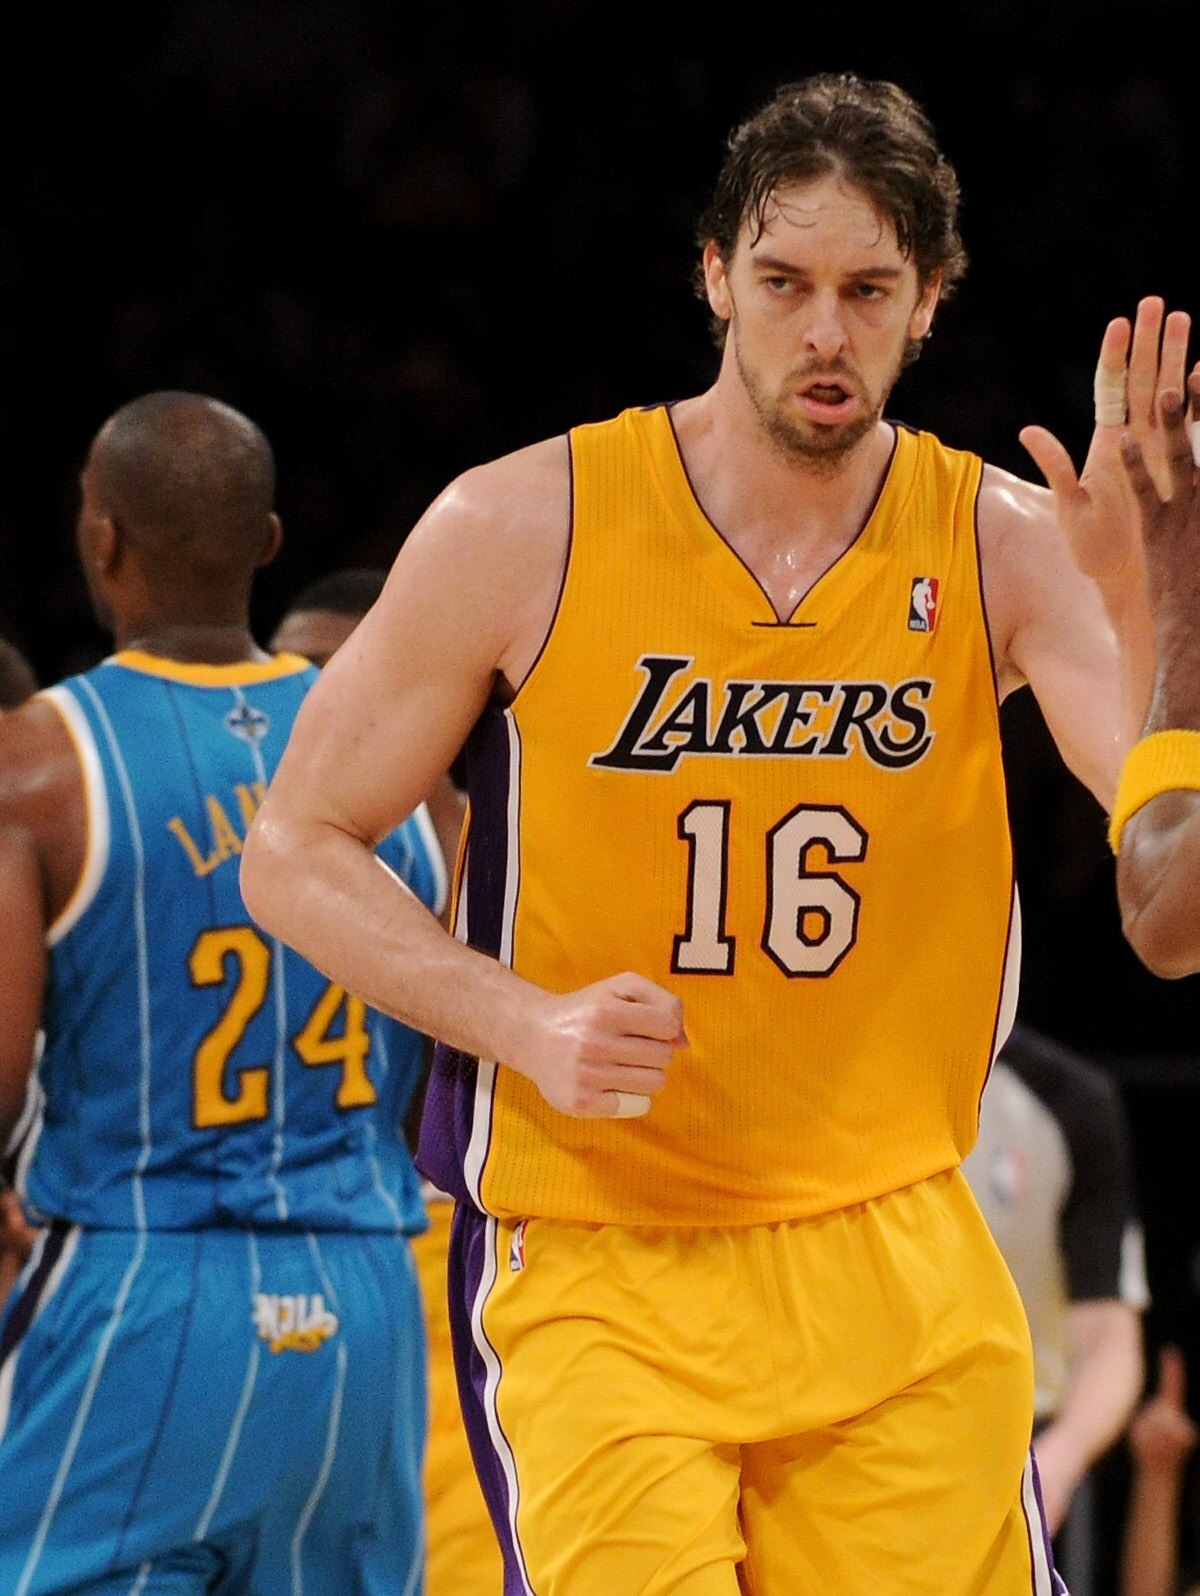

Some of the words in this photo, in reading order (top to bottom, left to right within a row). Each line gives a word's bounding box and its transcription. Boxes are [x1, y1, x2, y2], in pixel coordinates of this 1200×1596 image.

[586, 653, 936, 776] LAKERS
[670, 798, 869, 979] 16
[187, 923, 378, 1130] 24
